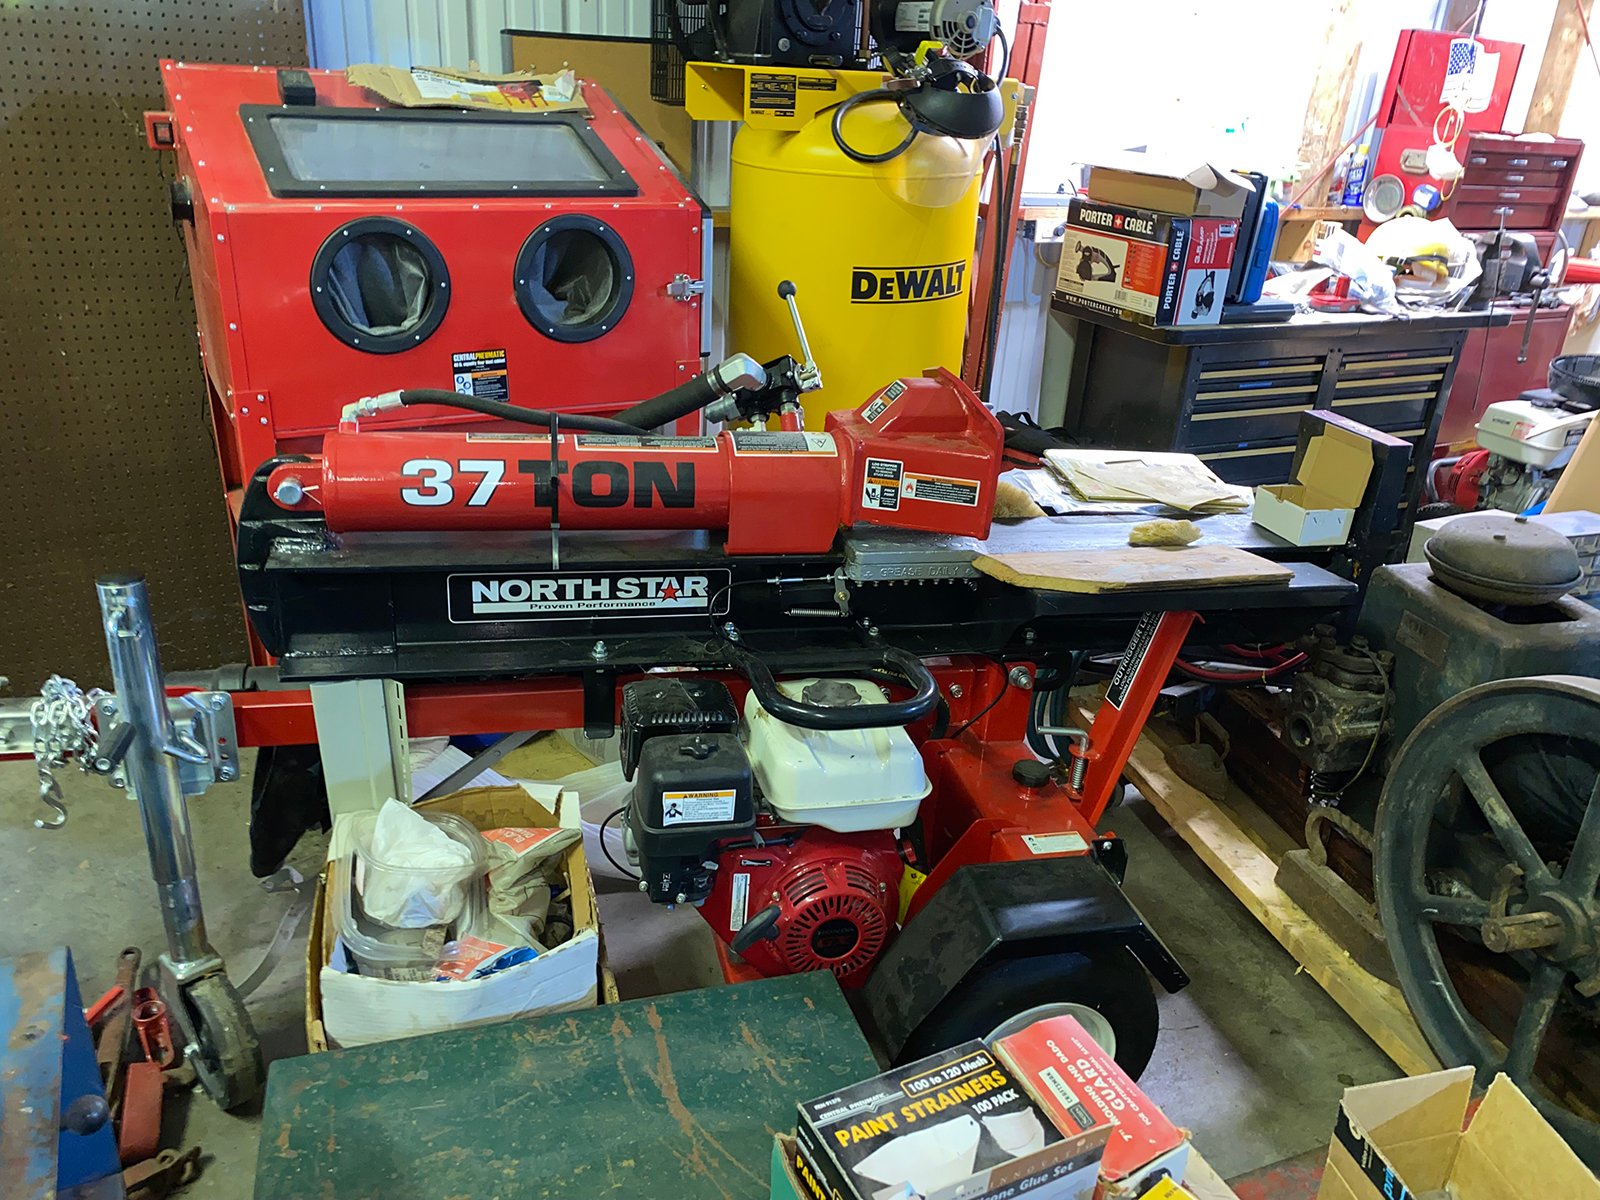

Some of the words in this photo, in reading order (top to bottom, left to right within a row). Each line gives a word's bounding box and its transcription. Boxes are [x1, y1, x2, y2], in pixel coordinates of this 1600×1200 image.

[1079, 208, 1113, 227] PORTER
[1124, 216, 1154, 235] CABLE
[1163, 272, 1176, 309] PORTER
[1172, 230, 1183, 259] CABLE
[400, 457, 506, 507] 37
[518, 460, 695, 509] TON
[880, 567, 922, 577] GREASE
[928, 566, 960, 576] DAILY
[472, 578, 610, 602] NORTH
[616, 576, 709, 599] STAR
[530, 602, 573, 610] Proven
[577, 600, 656, 609] Performance
[1113, 629, 1142, 685] OUTRIGGER
[1117, 683, 1128, 701] DOWN
[1126, 658, 1140, 683] POSITION
[1045, 1038, 1068, 1063] DADO
[908, 1081, 930, 1094] 100
[930, 1075, 942, 1086] to
[941, 1067, 961, 1081] 120
[961, 1056, 988, 1073] Mesh
[1066, 1063, 1085, 1084] AND
[1089, 1055, 1108, 1076] RADIAL
[1045, 1071, 1072, 1104] CRAFTSMAN
[1075, 1055, 1126, 1112] GUARD
[1107, 1076, 1139, 1111] CRAFTSMAN
[819, 1105, 849, 1120] CENTRAL
[848, 1092, 885, 1109] PNEUMATIC
[834, 1111, 898, 1147] PAINT
[900, 1070, 1007, 1123] STRAINERS
[972, 1099, 995, 1115] 100
[992, 1087, 1019, 1107] PACK
[1072, 1106, 1089, 1124] Sears
[1083, 1084, 1121, 1126] MOLDING
[1138, 1112, 1152, 1126] FOR
[796, 1155, 826, 1200] PAINT
[1019, 1172, 1048, 1191] Glue
[1052, 1162, 1074, 1178] Set
